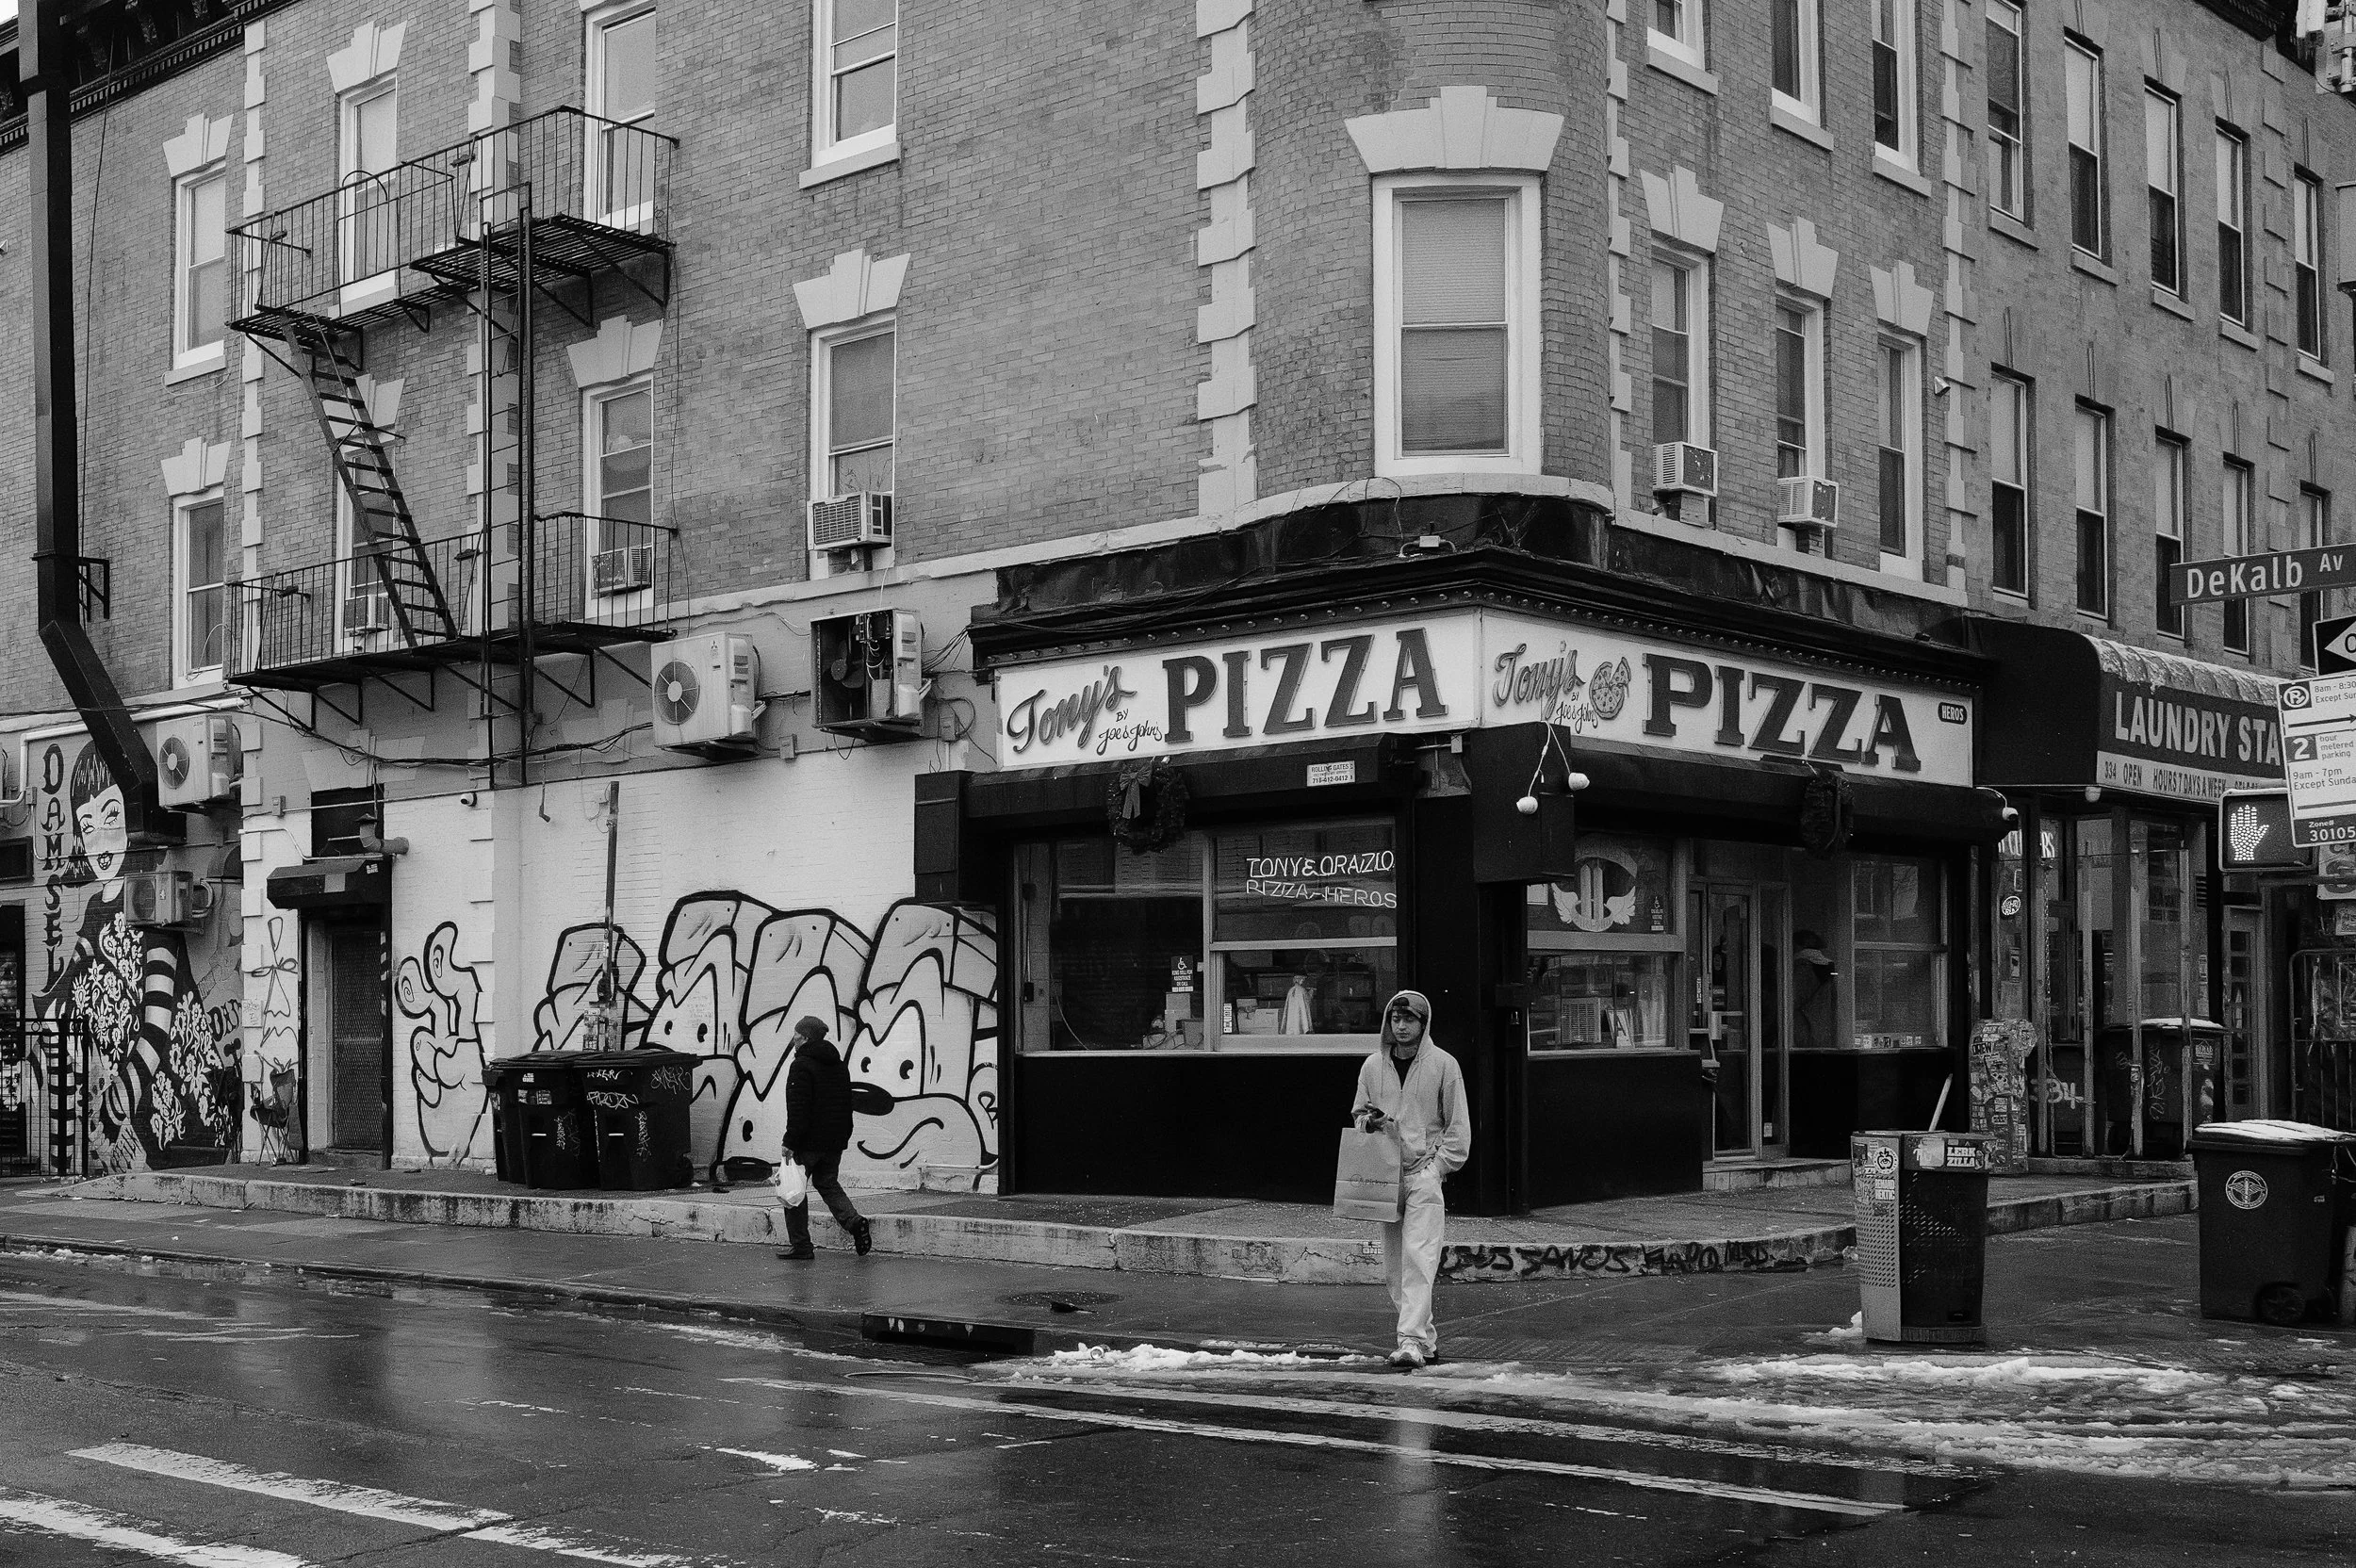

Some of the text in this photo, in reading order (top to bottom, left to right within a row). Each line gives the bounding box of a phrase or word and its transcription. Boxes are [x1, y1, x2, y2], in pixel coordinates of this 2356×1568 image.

[2186, 553, 2343, 598] DeKalb Av
[1162, 627, 1449, 743] PIZZA
[1492, 640, 1586, 721] Tony's
[2315, 694, 2341, 703] Except
[1006, 664, 1138, 754] Tony's
[1116, 709, 1129, 722] BY
[1642, 653, 1922, 772] PIZZA
[1941, 705, 1964, 722] HEROS
[2115, 692, 2232, 759] LAUNDRY
[2292, 738, 2310, 760] 2
[2320, 742, 2354, 751] metered
[2321, 750, 2351, 760] parking
[2104, 760, 2117, 780] 334
[2123, 762, 2143, 787] OPEN
[2153, 768, 2178, 793] HOURS
[2179, 773, 2182, 793] 7
[2184, 773, 2201, 795] DAYS
[2322, 768, 2343, 777] 7pm
[2294, 779, 2325, 791] Except
[2309, 826, 2356, 841] 30105
[34, 743, 66, 997] DAMSEL
[1946, 1156, 1975, 1168] ZILLA
